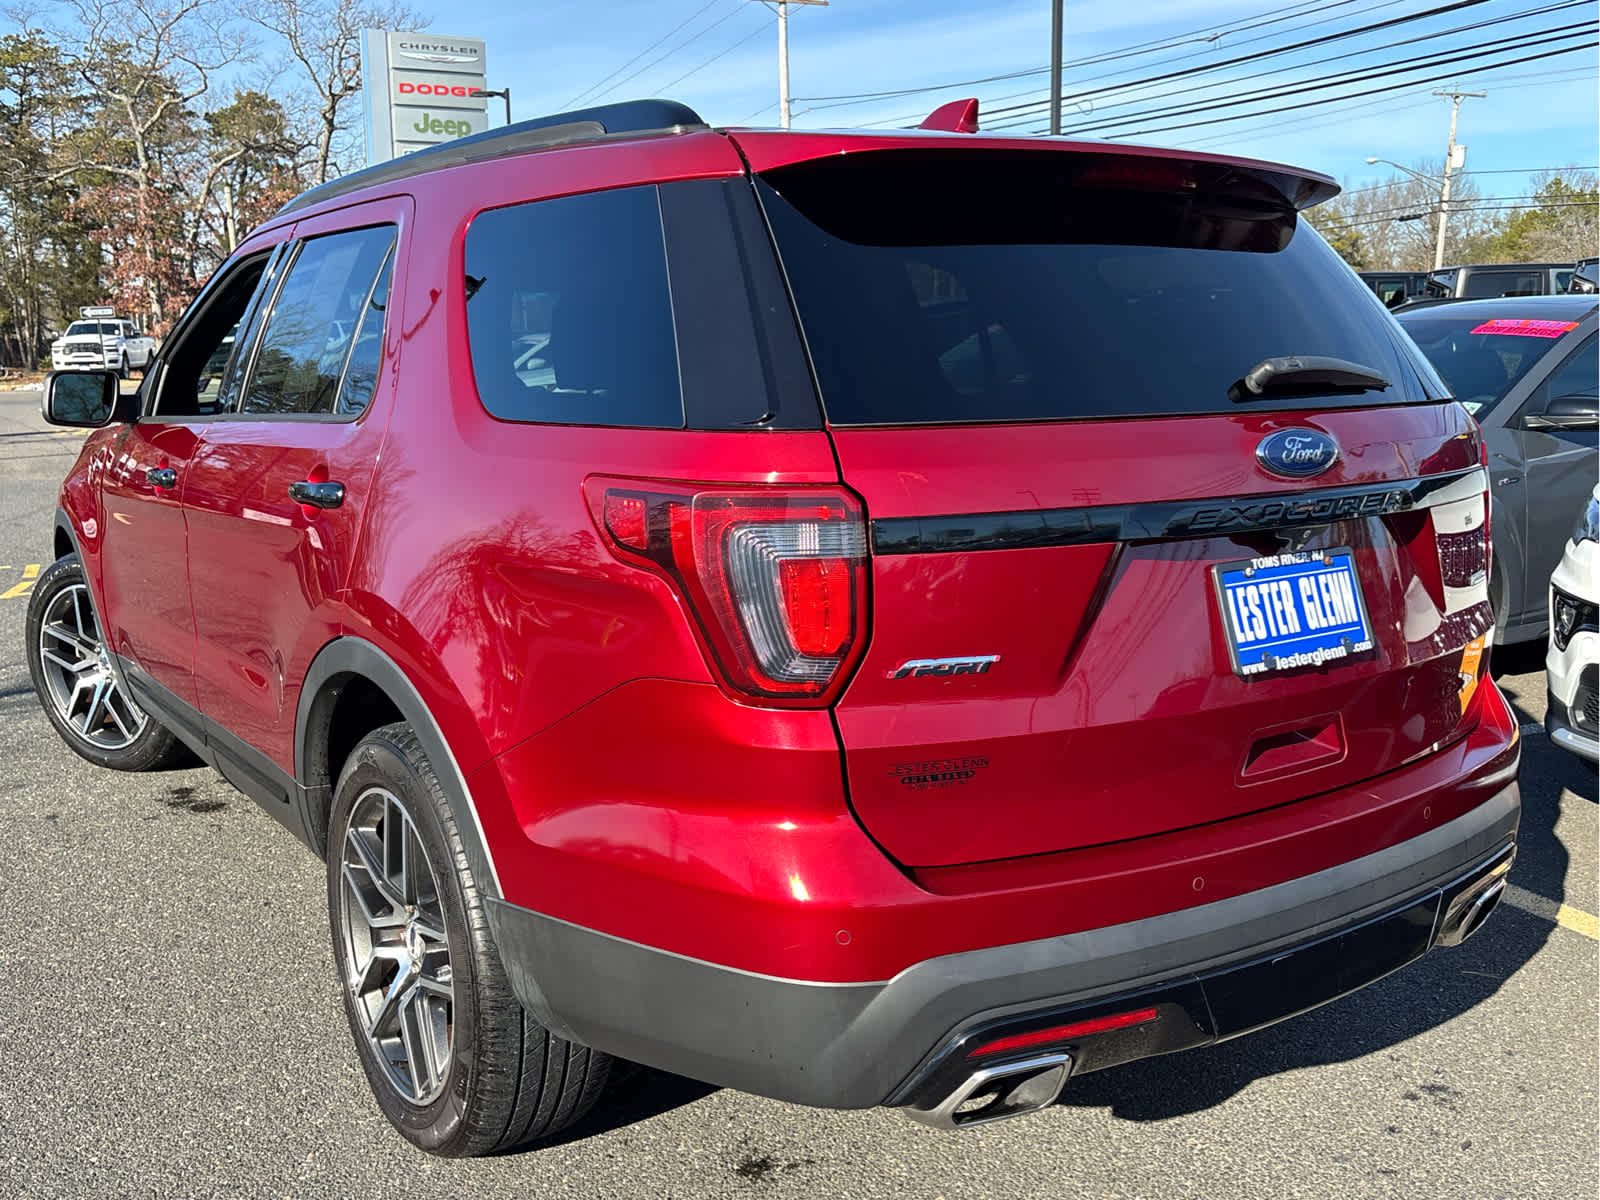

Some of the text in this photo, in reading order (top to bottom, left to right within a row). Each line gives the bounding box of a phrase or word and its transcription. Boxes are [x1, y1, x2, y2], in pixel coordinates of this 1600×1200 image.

[400, 42, 478, 54] CHRYSLER
[414, 112, 471, 138] Jeep
[1282, 436, 1325, 464] Ford
[1189, 491, 1404, 529] EXPLORER
[1251, 556, 1280, 570] TOMS
[1312, 550, 1324, 561] NJ
[1226, 571, 1359, 643] LESTER GLENN
